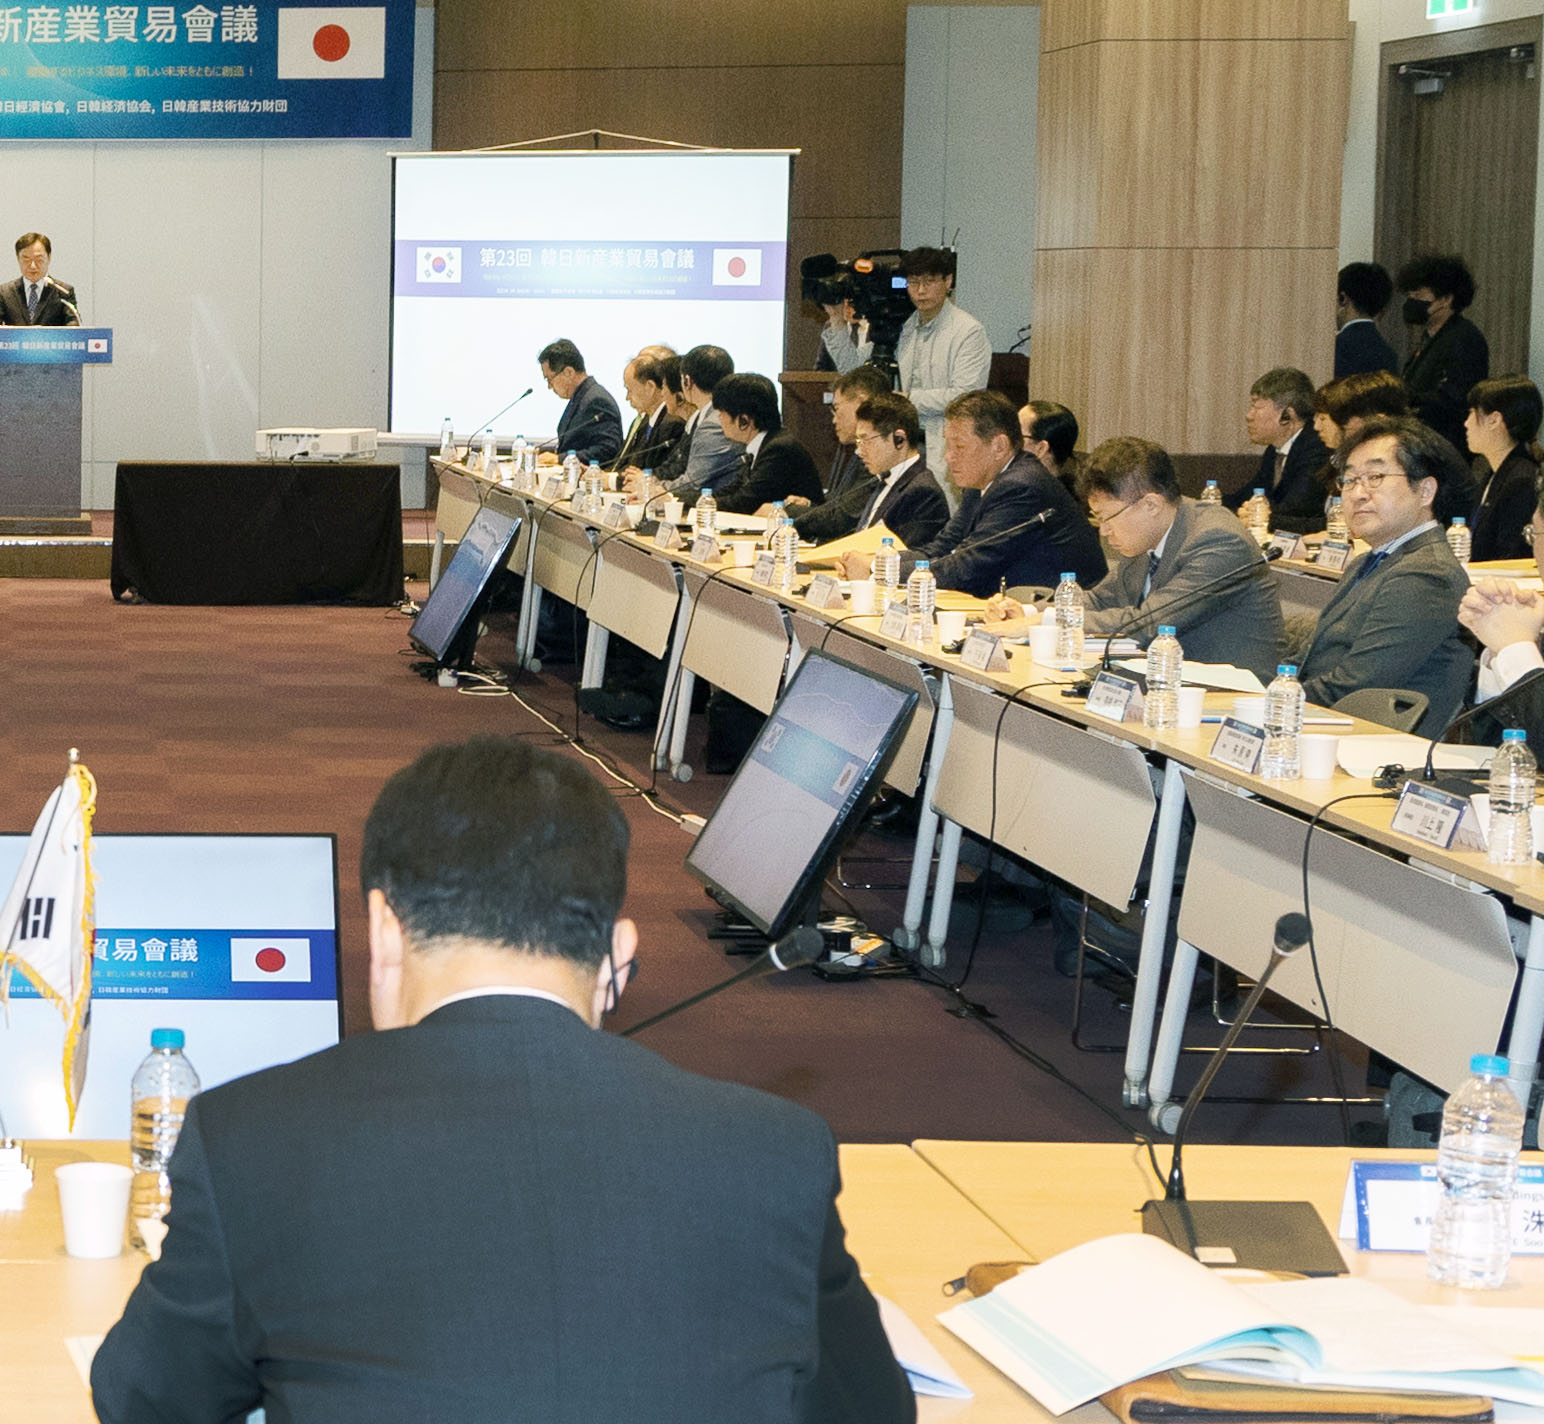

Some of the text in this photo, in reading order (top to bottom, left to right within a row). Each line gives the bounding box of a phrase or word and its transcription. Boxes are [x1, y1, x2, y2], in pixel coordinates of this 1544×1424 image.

[162, 99, 288, 114] 日韓産業技術協力財団
[479, 247, 532, 268] 第23回
